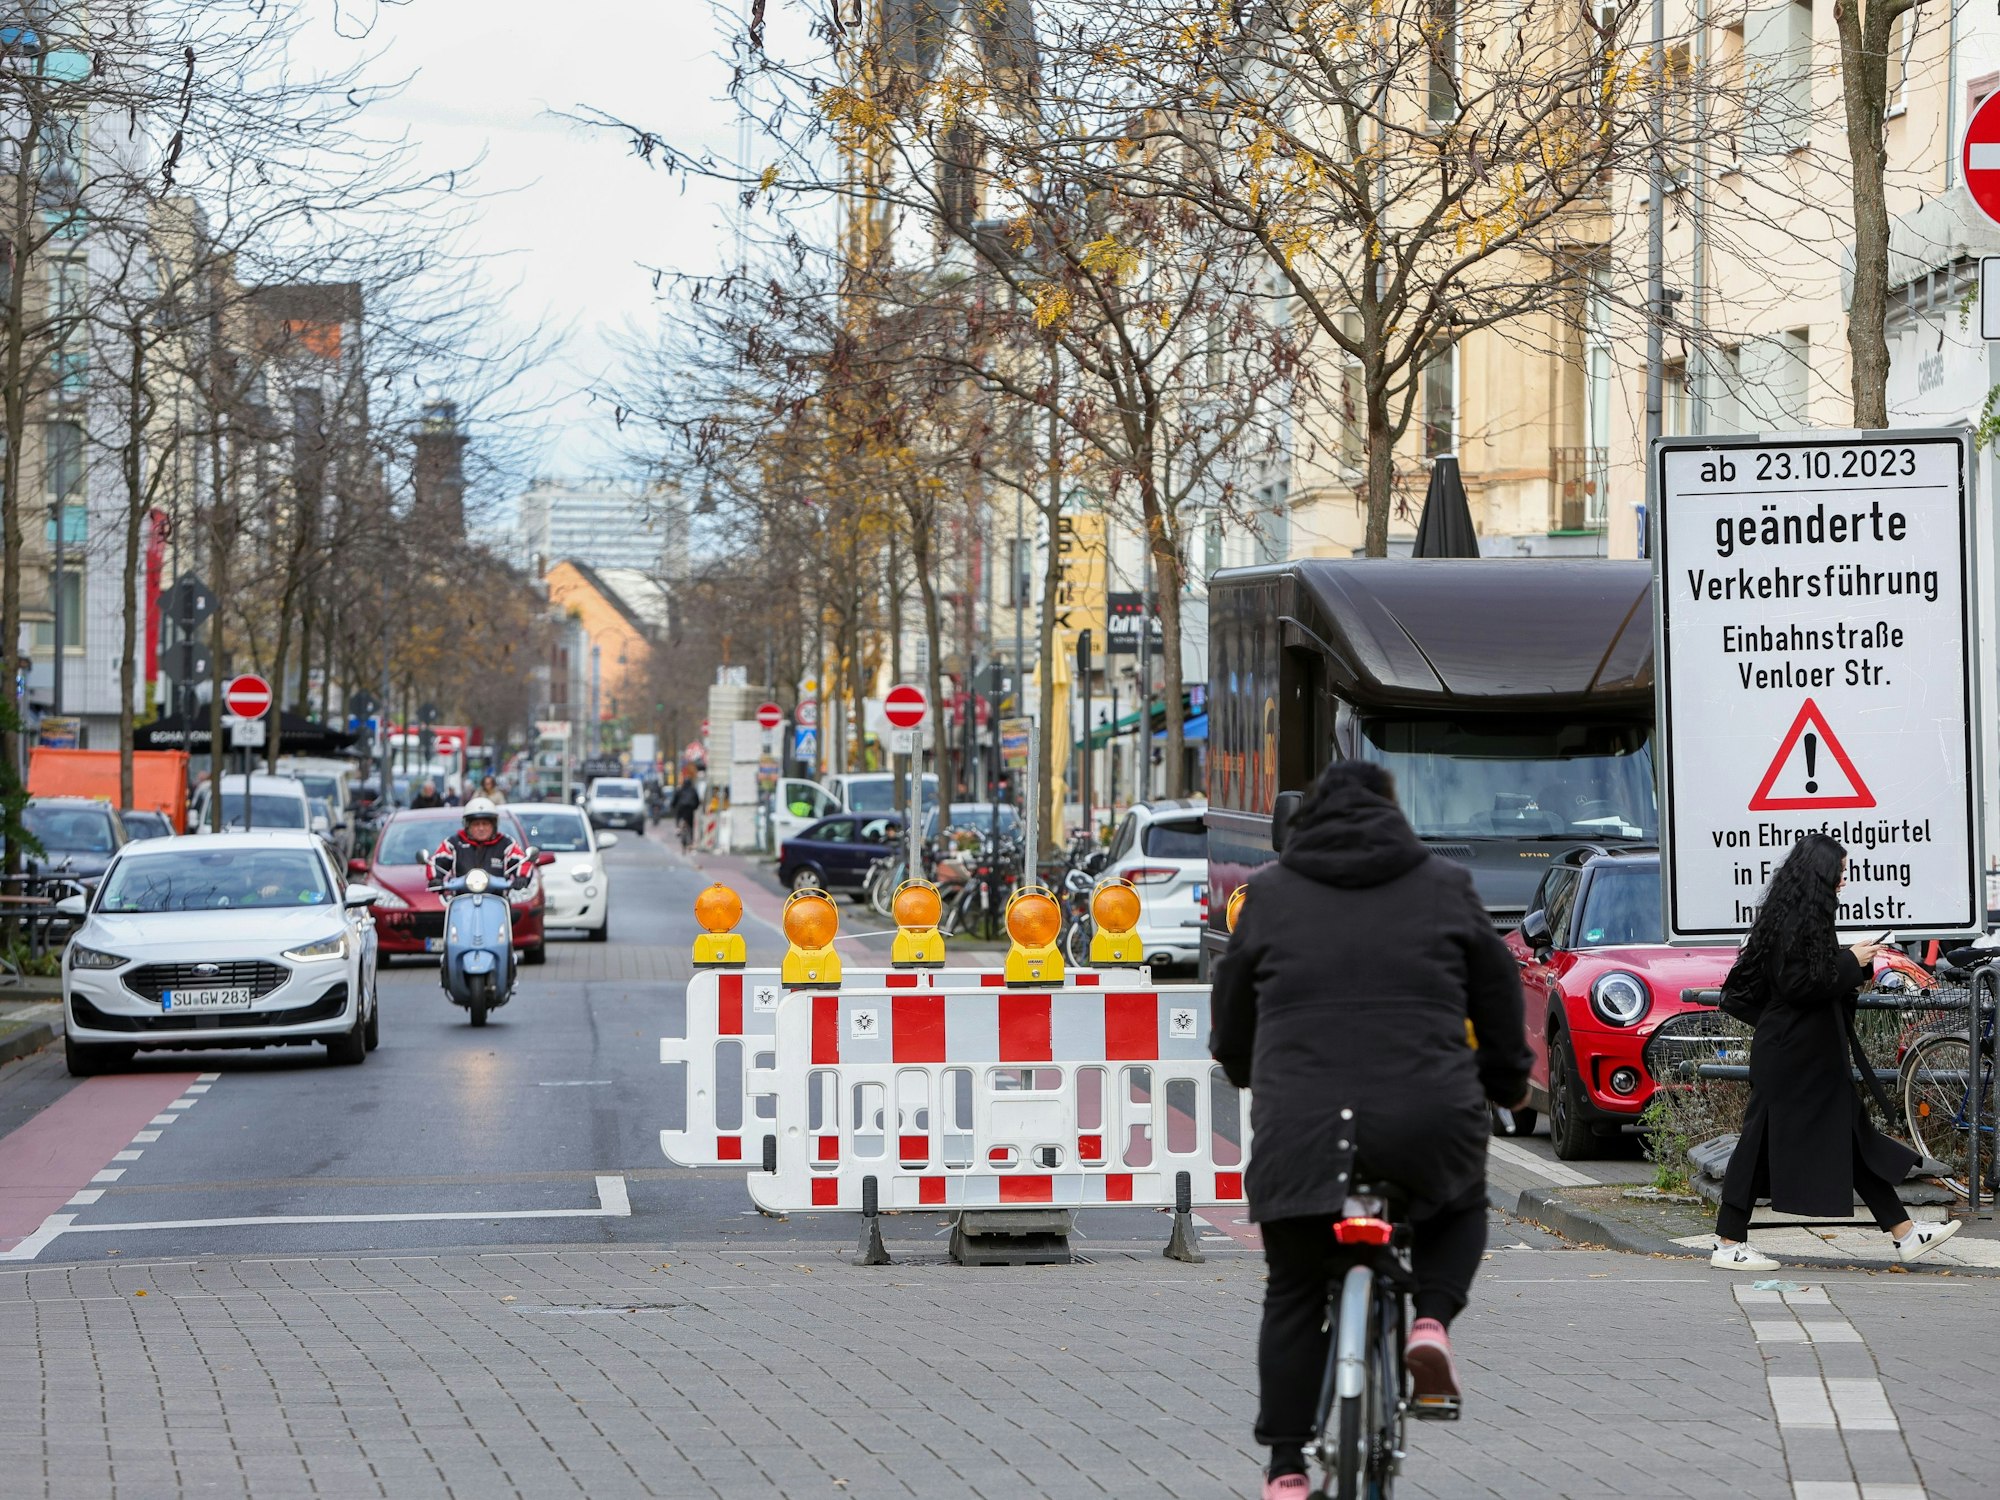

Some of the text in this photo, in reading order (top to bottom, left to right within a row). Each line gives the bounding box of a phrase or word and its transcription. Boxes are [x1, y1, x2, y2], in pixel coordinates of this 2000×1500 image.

[1700, 449, 1916, 482] ab 23.10.2023
[1716, 501, 1907, 558] geänderte
[1687, 565, 1939, 603] Verkehrsführung
[1723, 621, 1904, 653] Einbahnstraße
[1738, 658, 1891, 690] Venloer Str.
[1712, 830, 1750, 848] von
[1734, 861, 1752, 885] in
[173, 990, 248, 1006] SU GW 283
